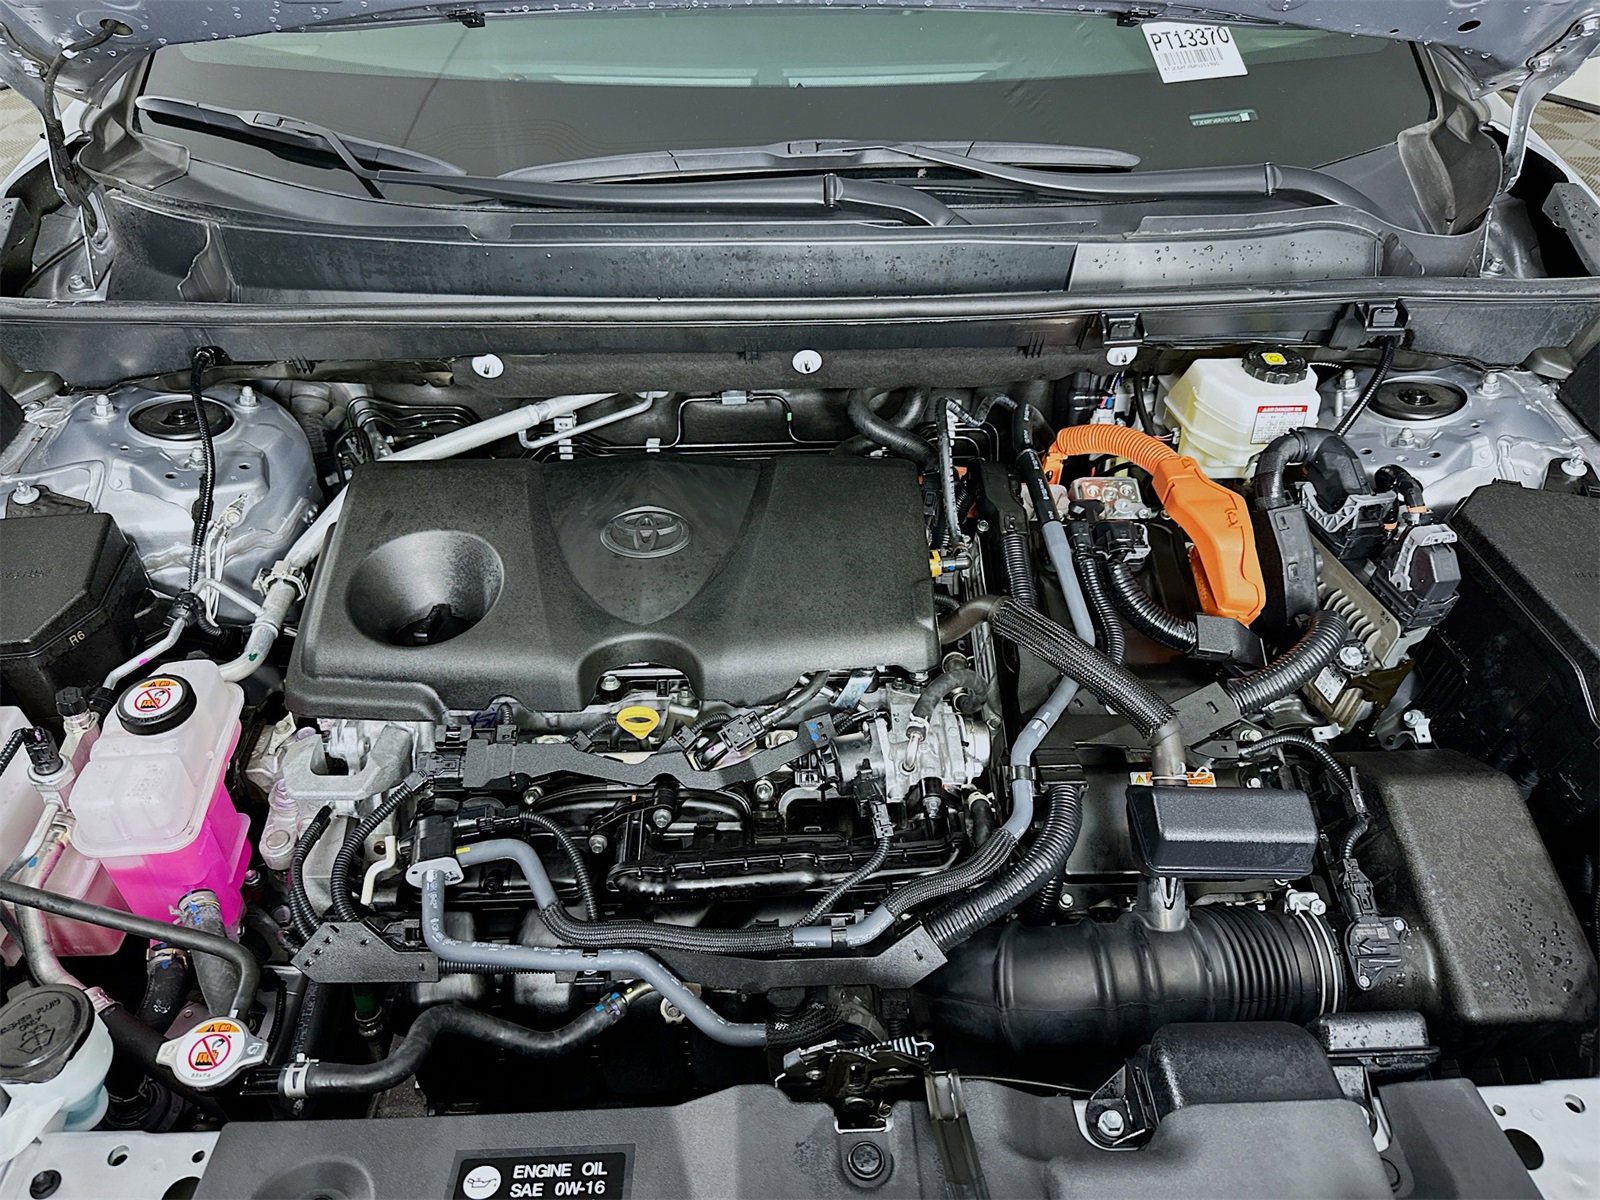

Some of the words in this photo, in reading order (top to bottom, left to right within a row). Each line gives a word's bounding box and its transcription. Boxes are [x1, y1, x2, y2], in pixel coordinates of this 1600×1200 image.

[1150, 26, 1230, 51] PT13370
[68, 631, 86, 647] R6
[513, 1163, 572, 1179] ENGINE
[581, 1162, 607, 1176] OIL
[509, 1182, 544, 1198] SAE
[554, 1180, 606, 1197] 0W-16
